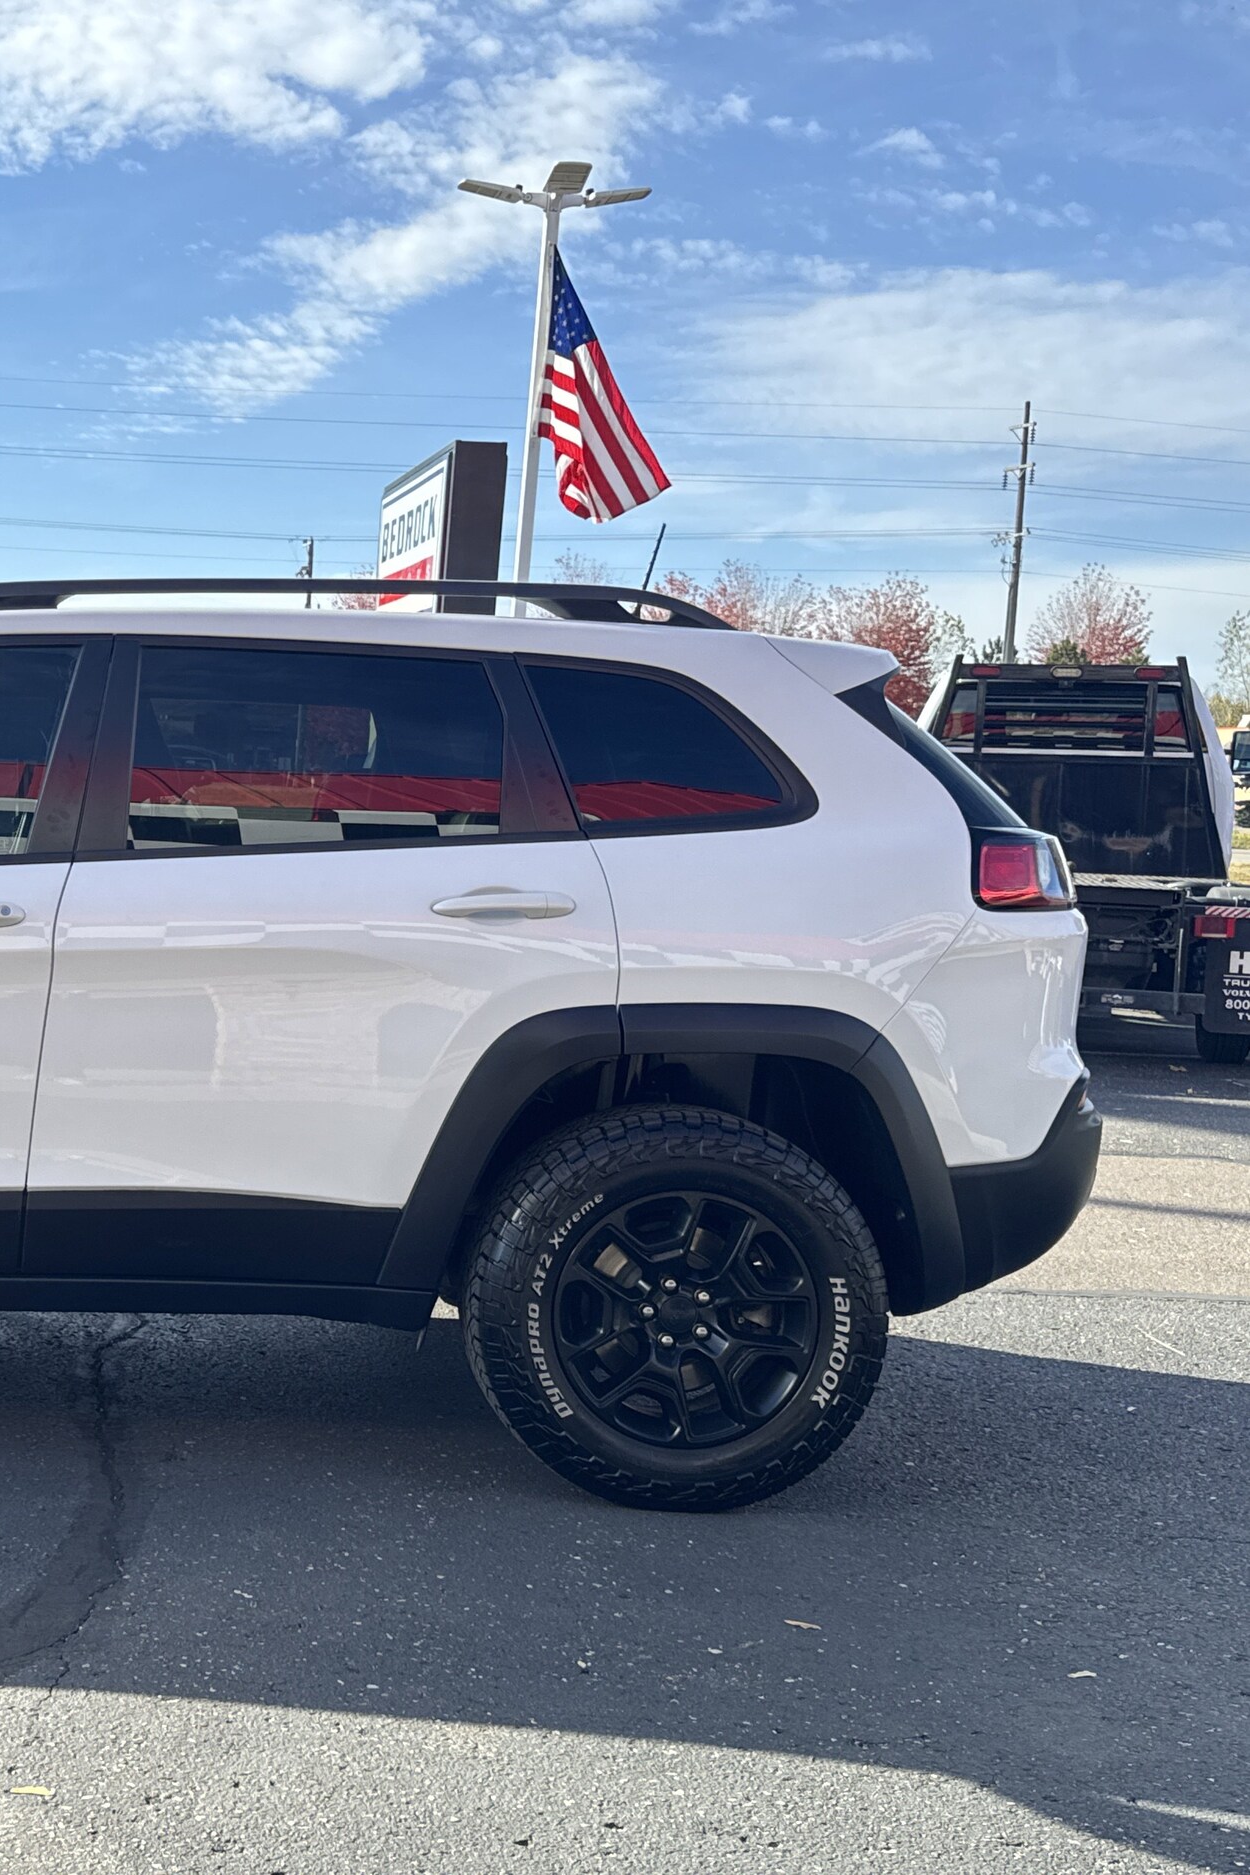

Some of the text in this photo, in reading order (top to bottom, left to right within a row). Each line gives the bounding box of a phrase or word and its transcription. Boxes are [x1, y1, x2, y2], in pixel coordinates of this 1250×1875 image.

[381, 494, 438, 563] BEDROCK
[1225, 999, 1250, 1010] 800
[532, 1254, 552, 1296] AT2
[548, 1193, 604, 1251] Xtreme
